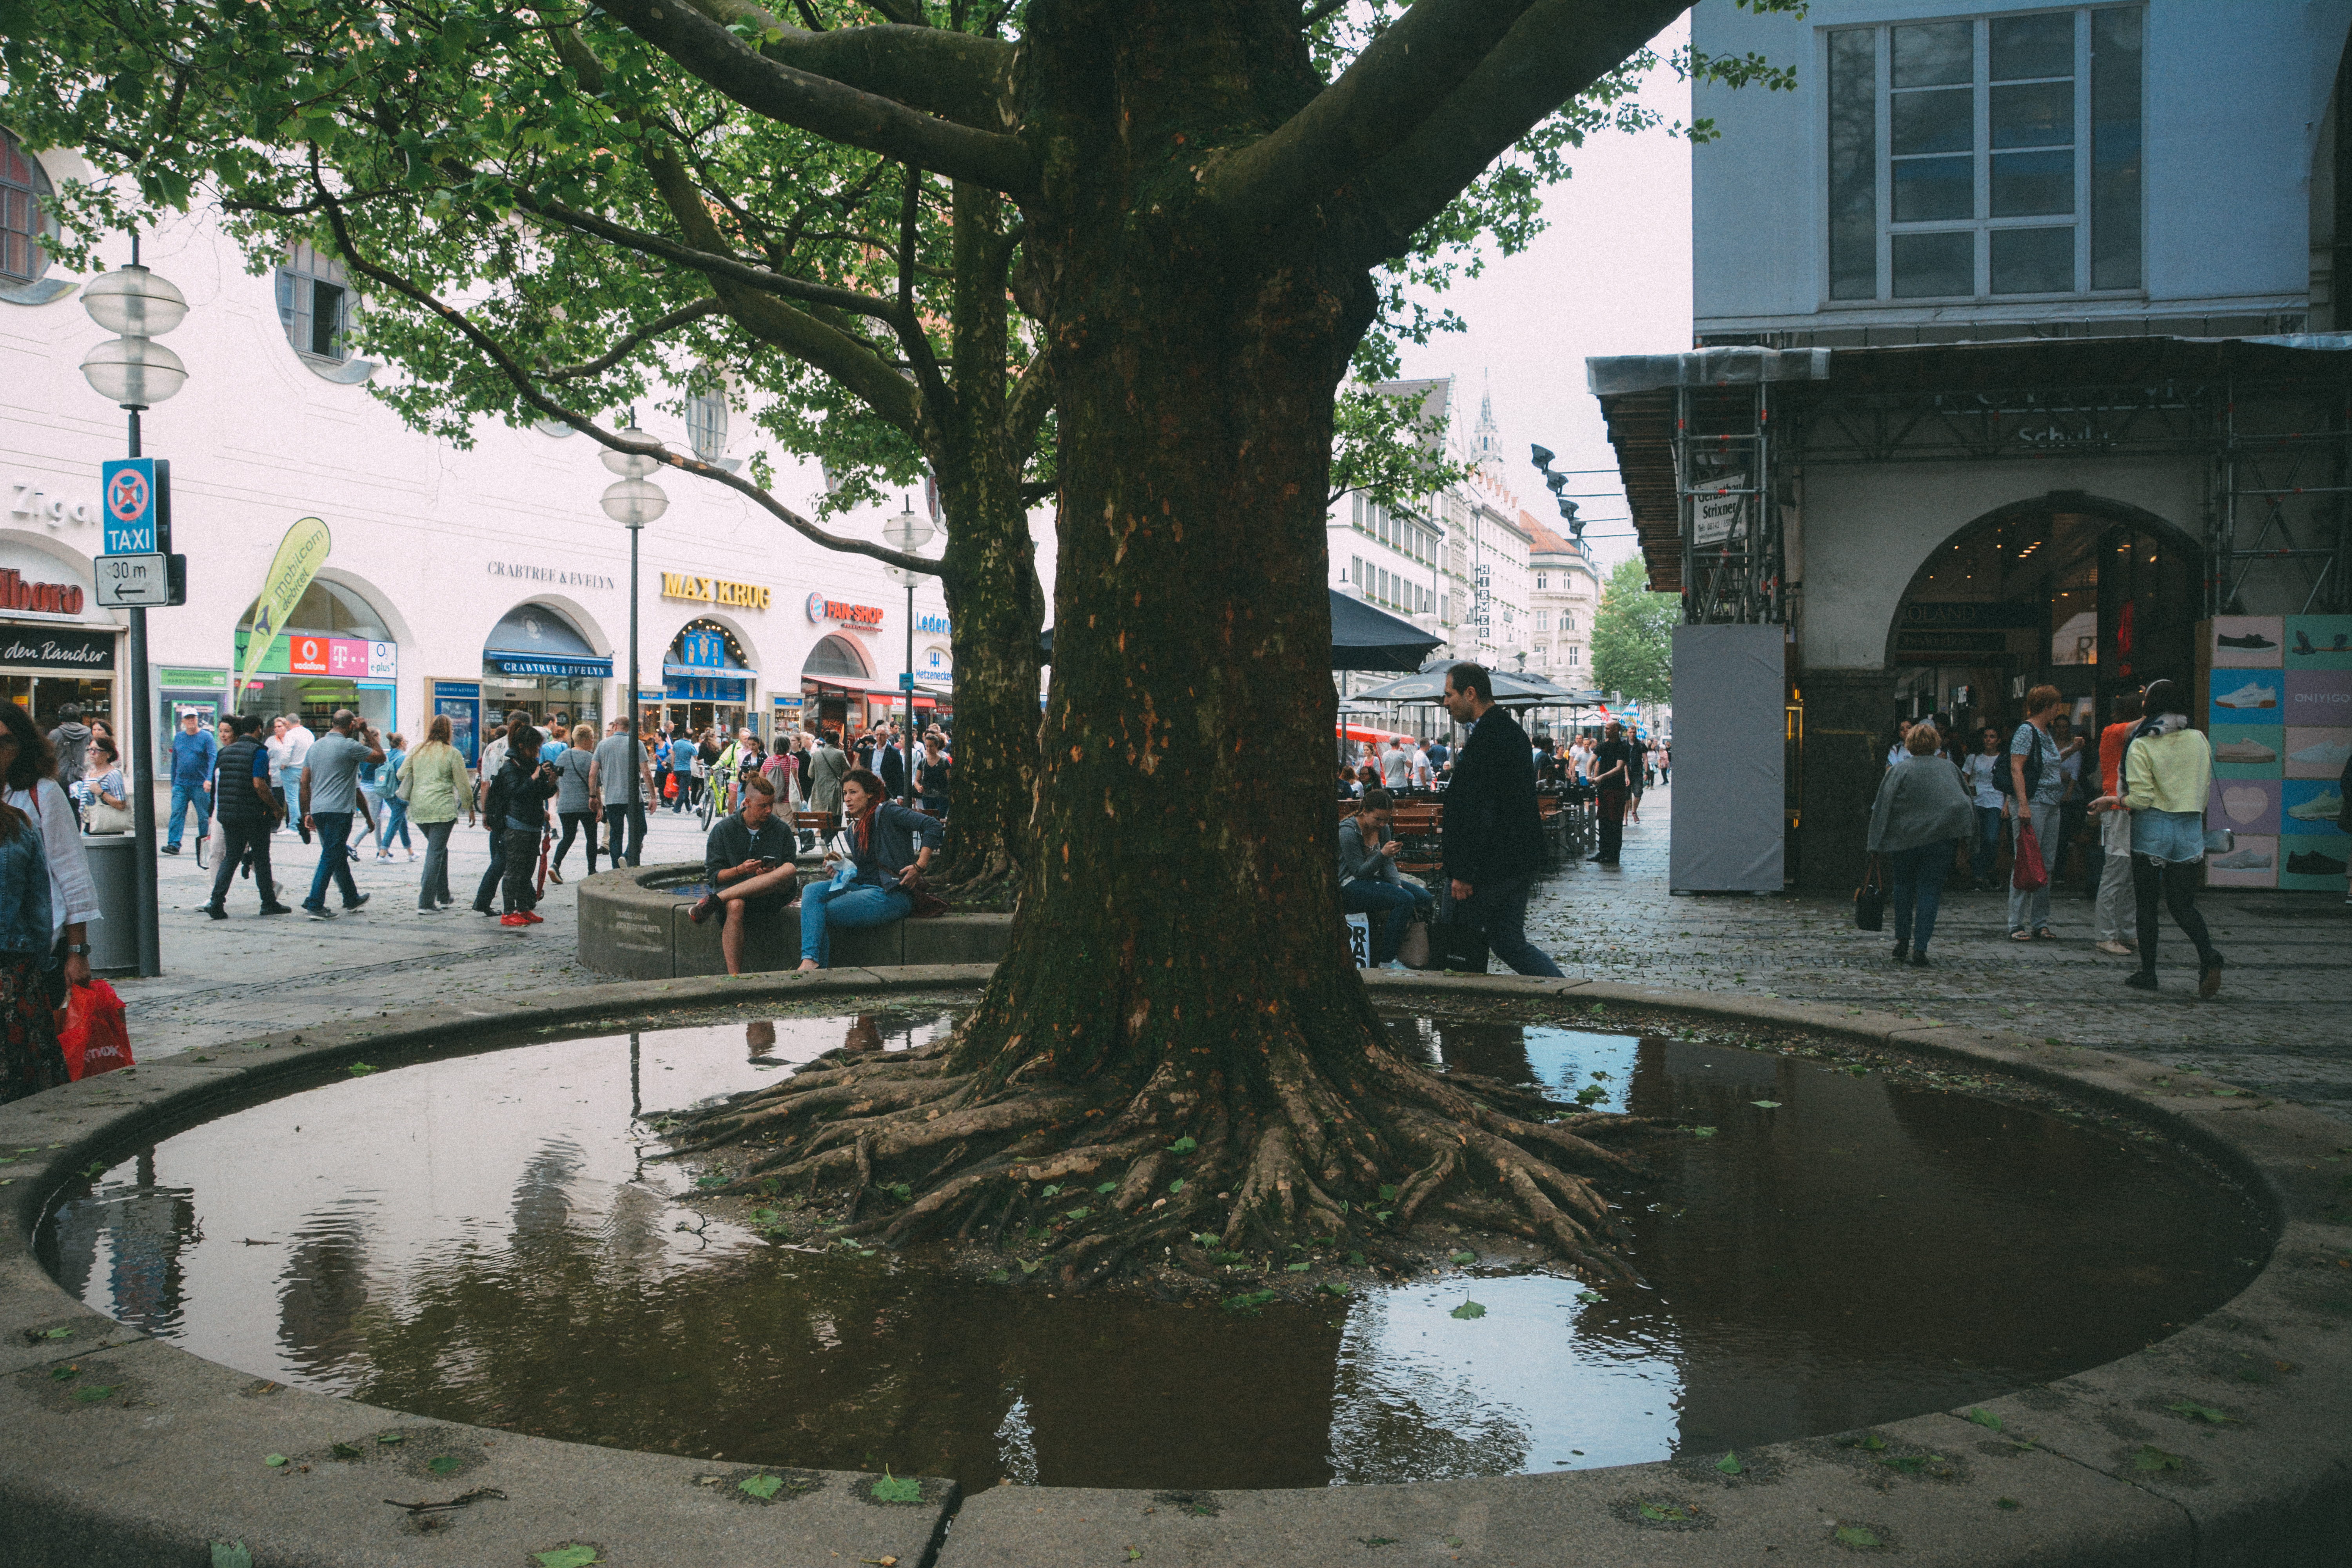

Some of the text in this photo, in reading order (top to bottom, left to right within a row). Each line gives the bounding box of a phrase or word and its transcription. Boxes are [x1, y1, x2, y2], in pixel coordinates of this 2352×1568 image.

[1703, 503, 1737, 519] Strixner
[108, 529, 150, 550] TAXI
[112, 561, 147, 579] 30 m
[275, 530, 323, 599] mobilcom
[488, 561, 614, 590] CRABTREE & EVELYN
[282, 567, 309, 611] debitel
[662, 572, 772, 610] MAX KRUG
[1479, 564, 1490, 637] HIRMER
[828, 600, 884, 624] FAN-SHOP
[1904, 605, 1976, 621] OLAND
[4, 641, 108, 662] den Raucher
[294, 661, 326, 671] vodafone
[503, 662, 558, 673] CRABTREE
[568, 666, 605, 675] EVELYN
